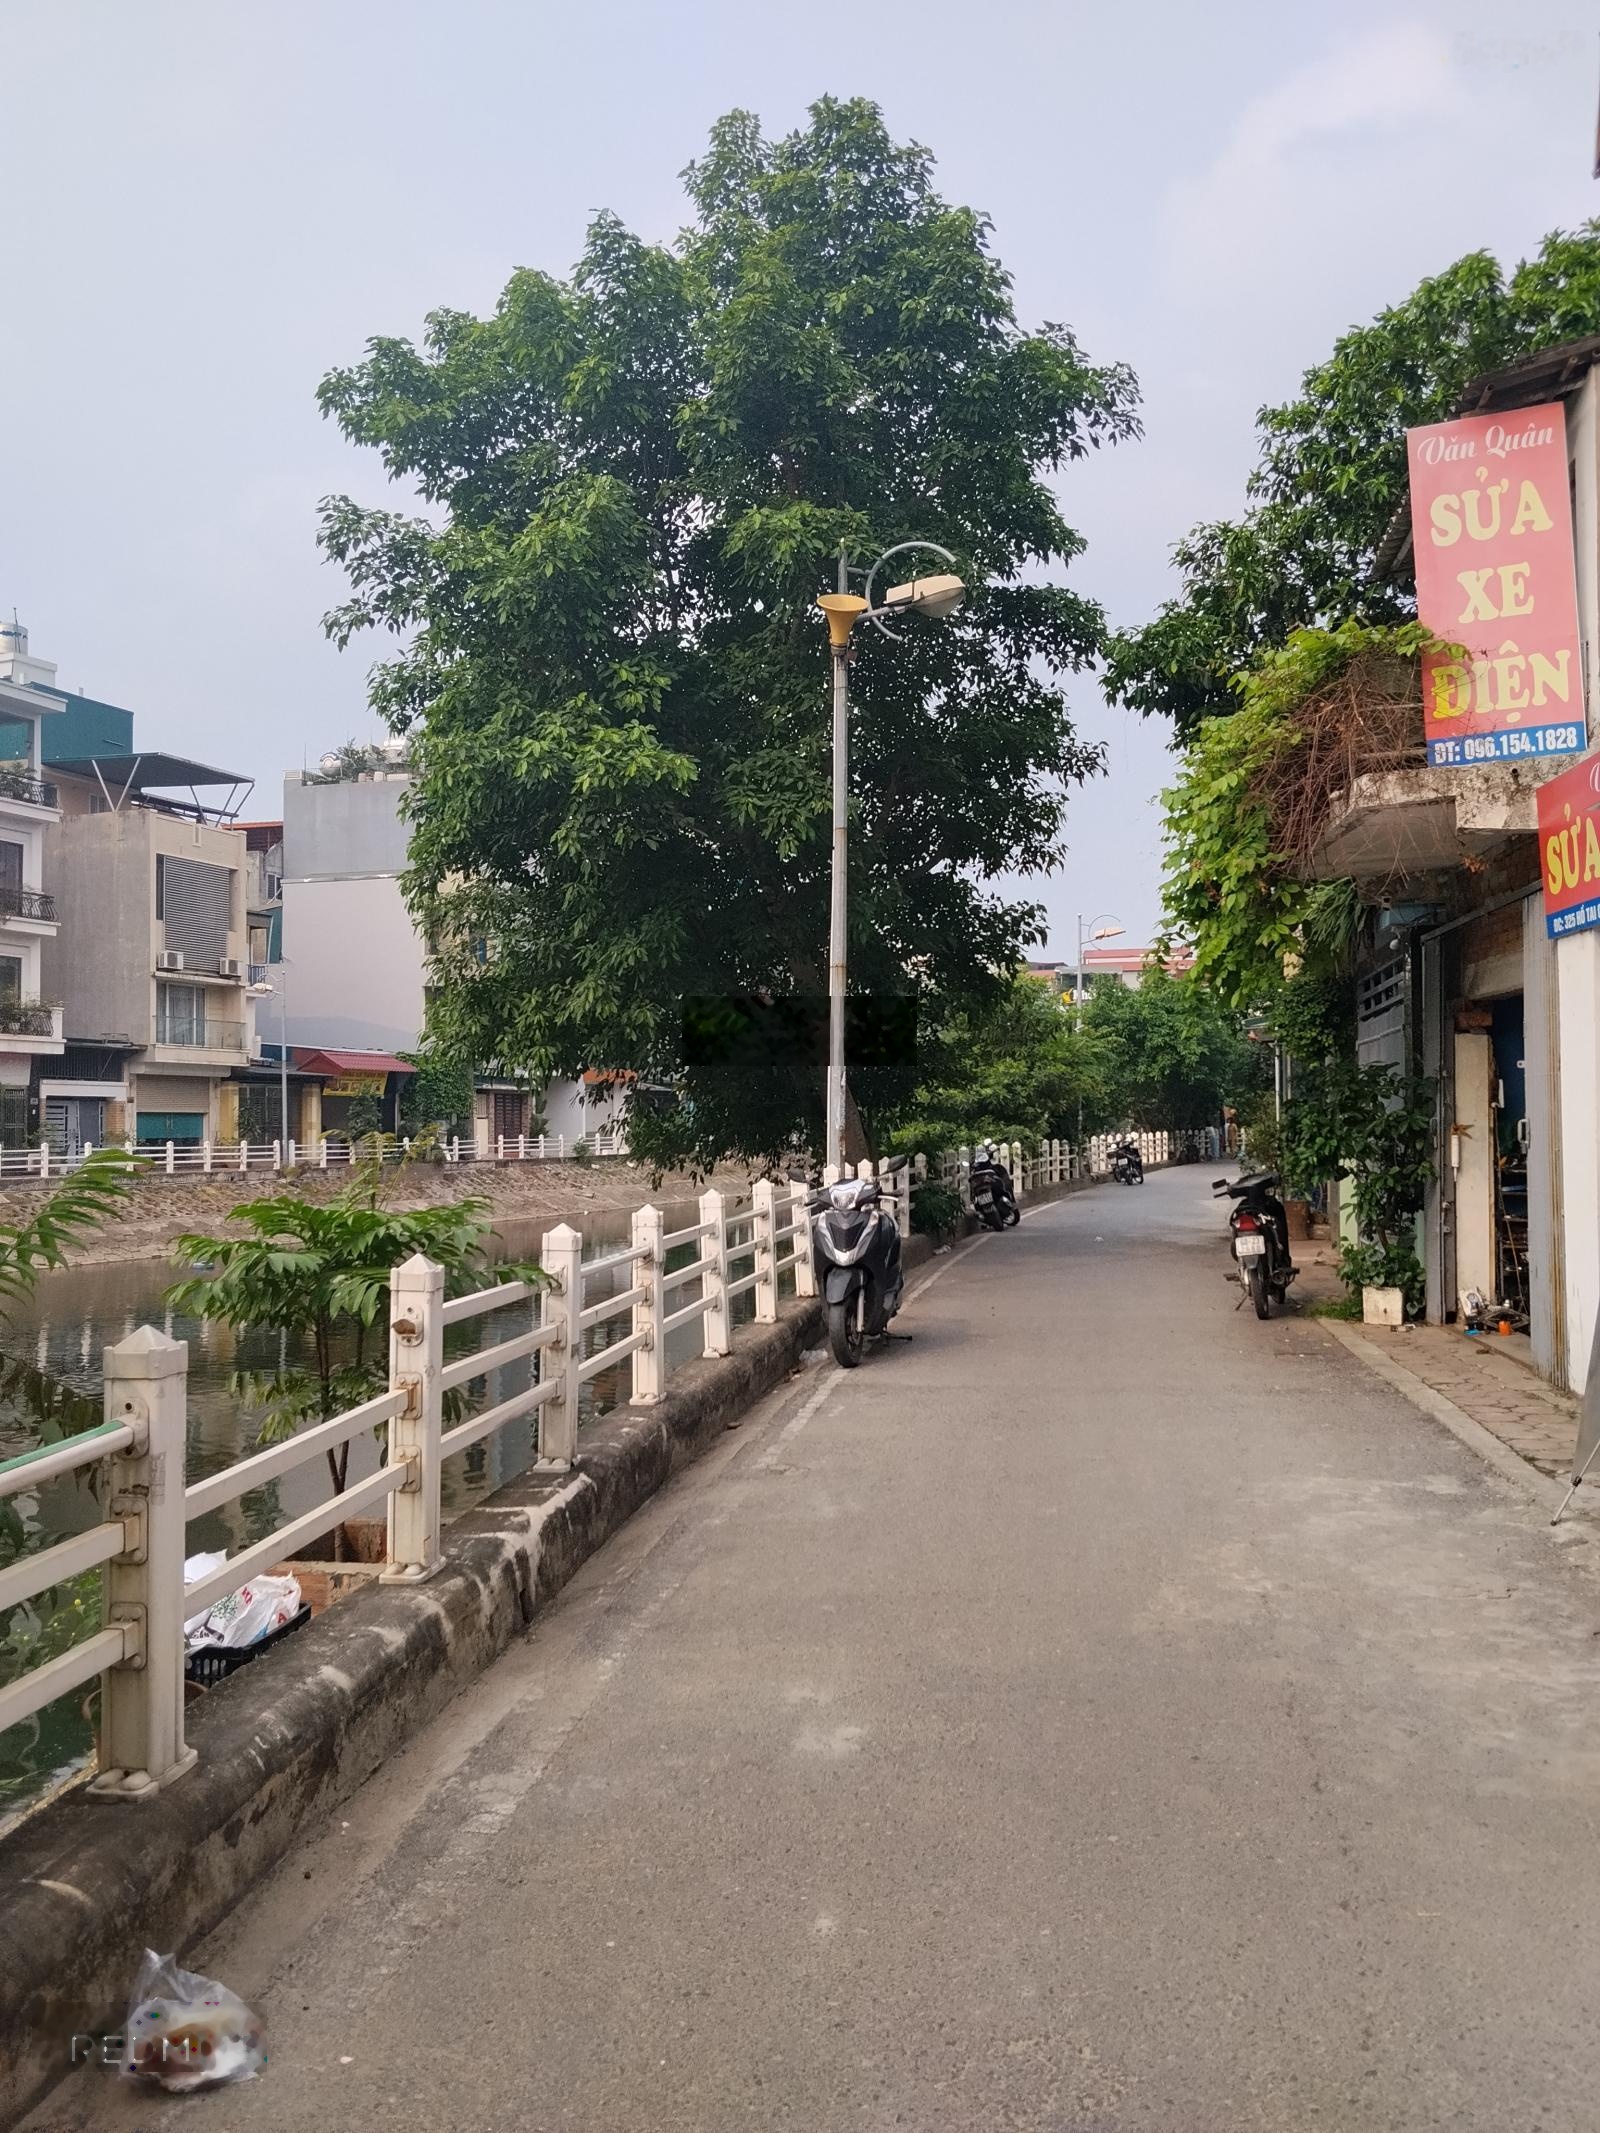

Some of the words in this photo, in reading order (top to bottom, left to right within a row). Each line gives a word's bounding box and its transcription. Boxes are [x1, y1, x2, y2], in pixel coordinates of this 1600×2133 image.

[1417, 434, 1477, 465] Văn
[1485, 422, 1555, 459] Quân
[1430, 466, 1554, 547] SỬA
[1456, 561, 1535, 624] XE
[1431, 639, 1571, 723] ĐIỆN
[1464, 726, 1578, 761] 096.154.1828
[1546, 802, 1600, 896] SỬA
